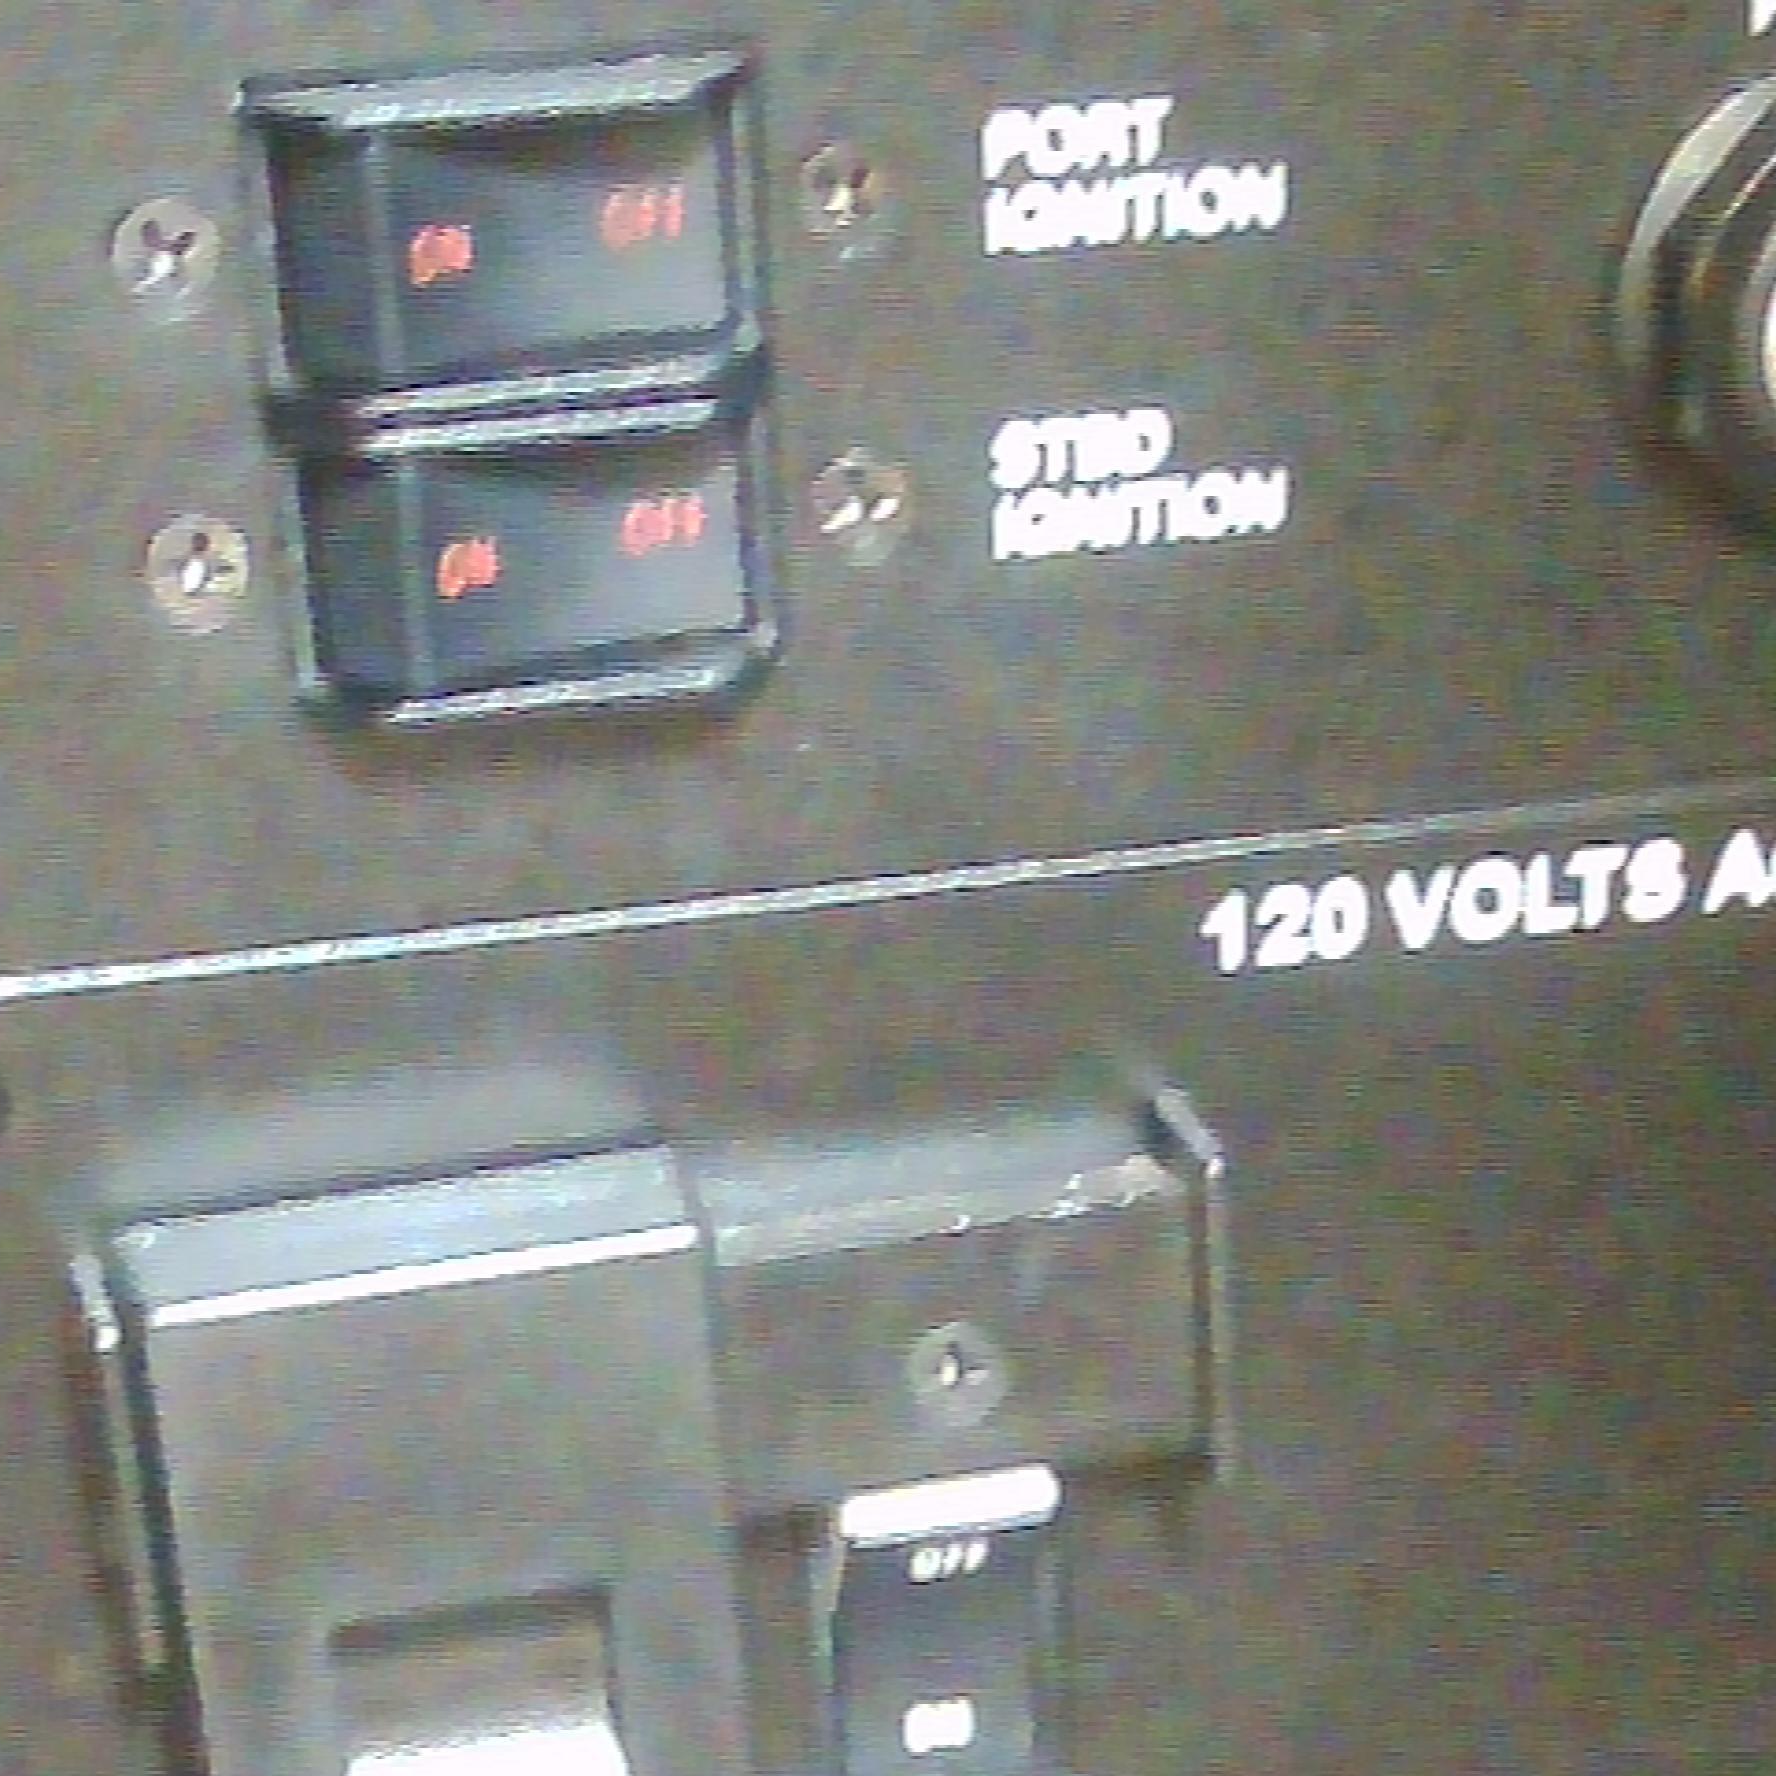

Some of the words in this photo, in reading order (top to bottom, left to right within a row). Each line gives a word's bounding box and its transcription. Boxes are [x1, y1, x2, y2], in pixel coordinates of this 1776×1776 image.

[981, 98, 1174, 182] PORT
[984, 163, 1290, 256] IGNITION
[990, 466, 1290, 560] IGNITION
[1199, 873, 1370, 972] 120
[1382, 838, 1687, 950] VOLTS
